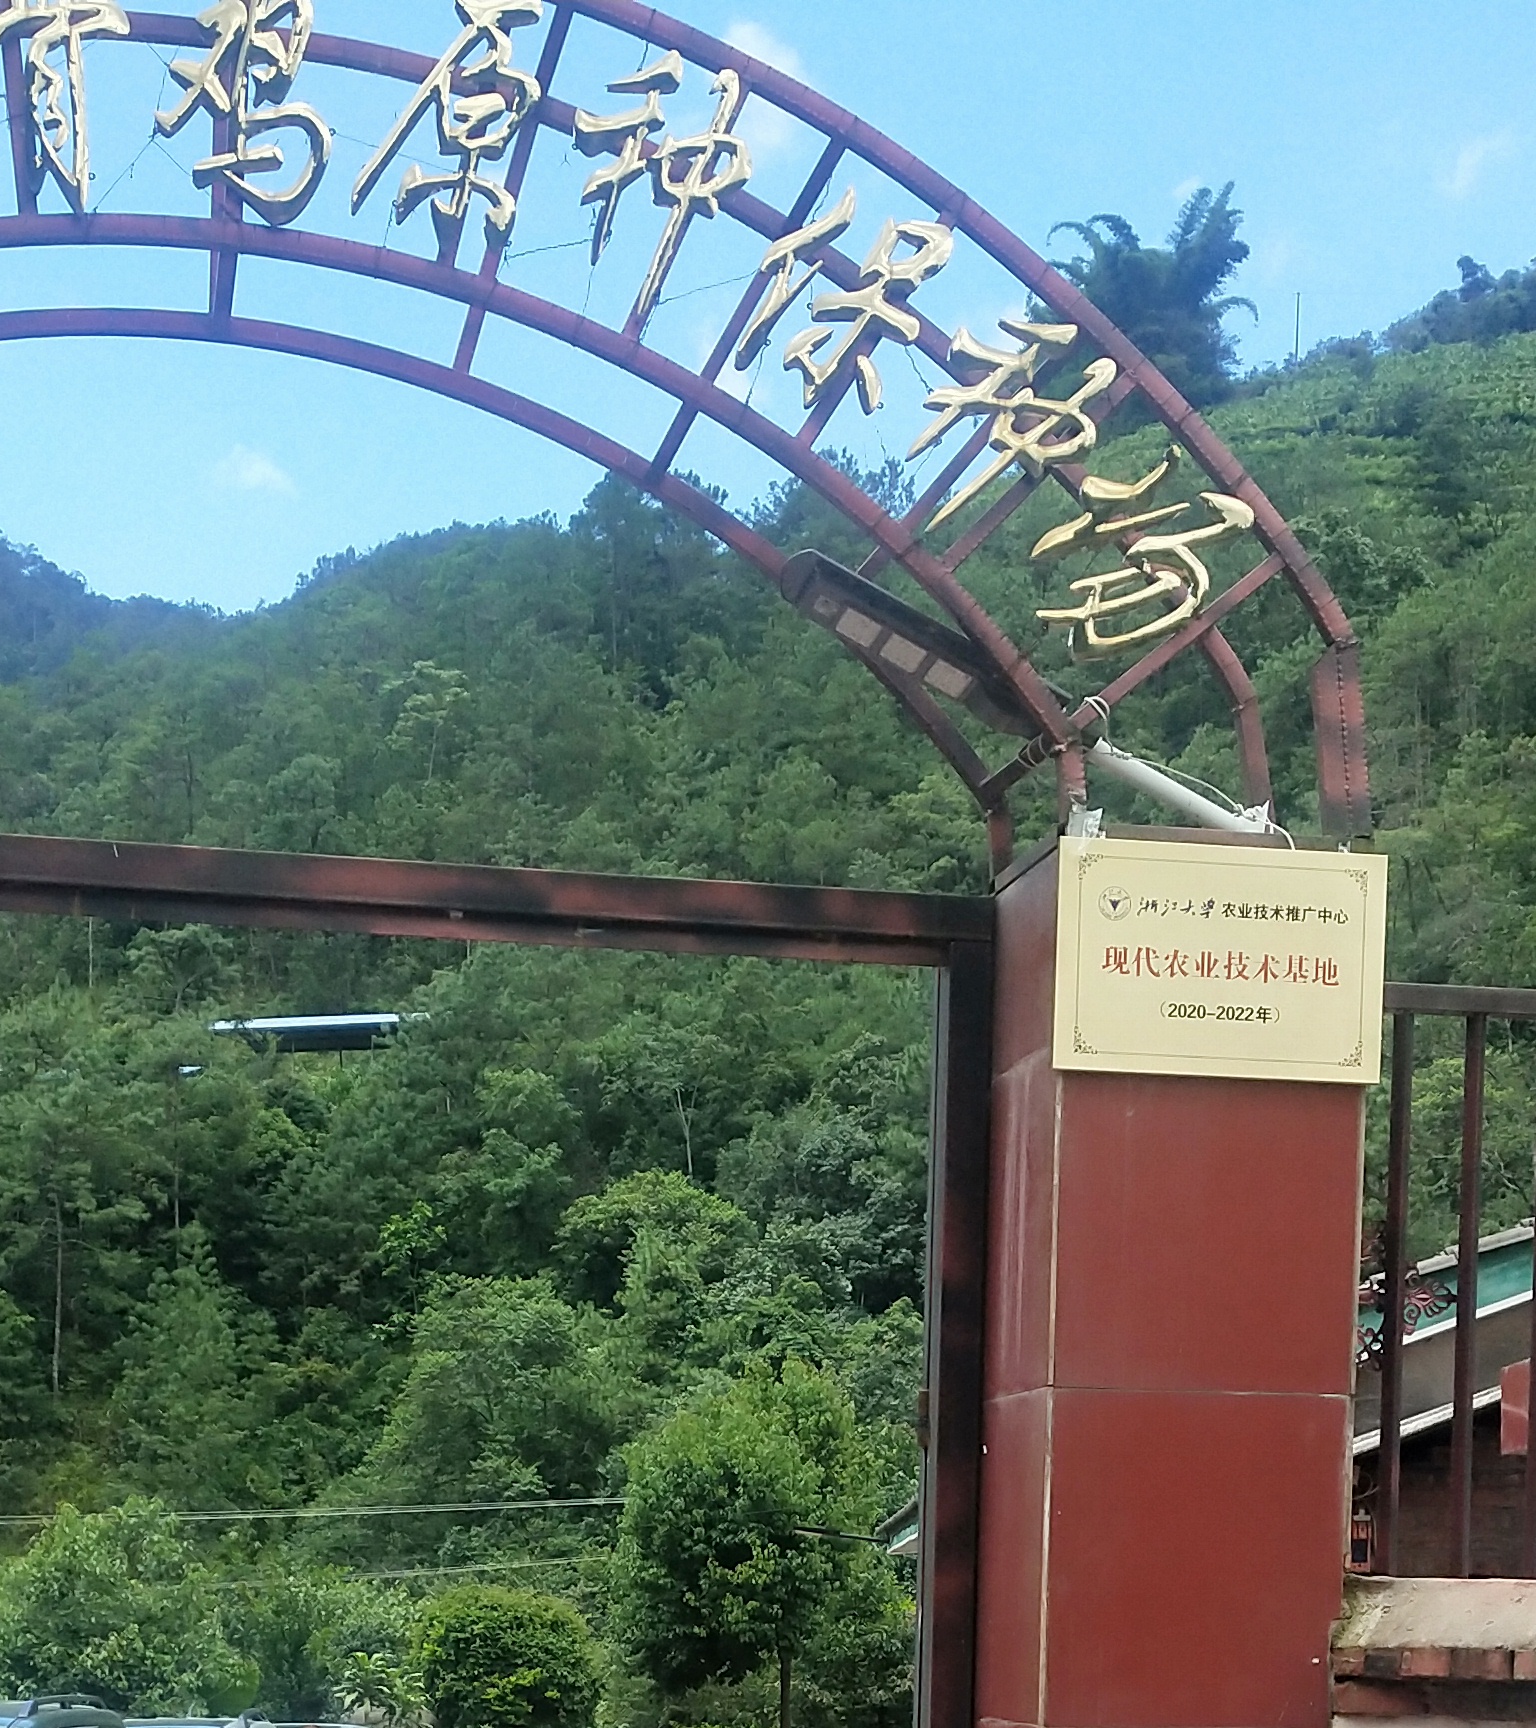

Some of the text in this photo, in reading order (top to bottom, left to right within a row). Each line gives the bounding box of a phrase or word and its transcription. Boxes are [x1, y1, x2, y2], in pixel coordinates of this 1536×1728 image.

[1101, 945, 1340, 987] 现代农业技术基地
